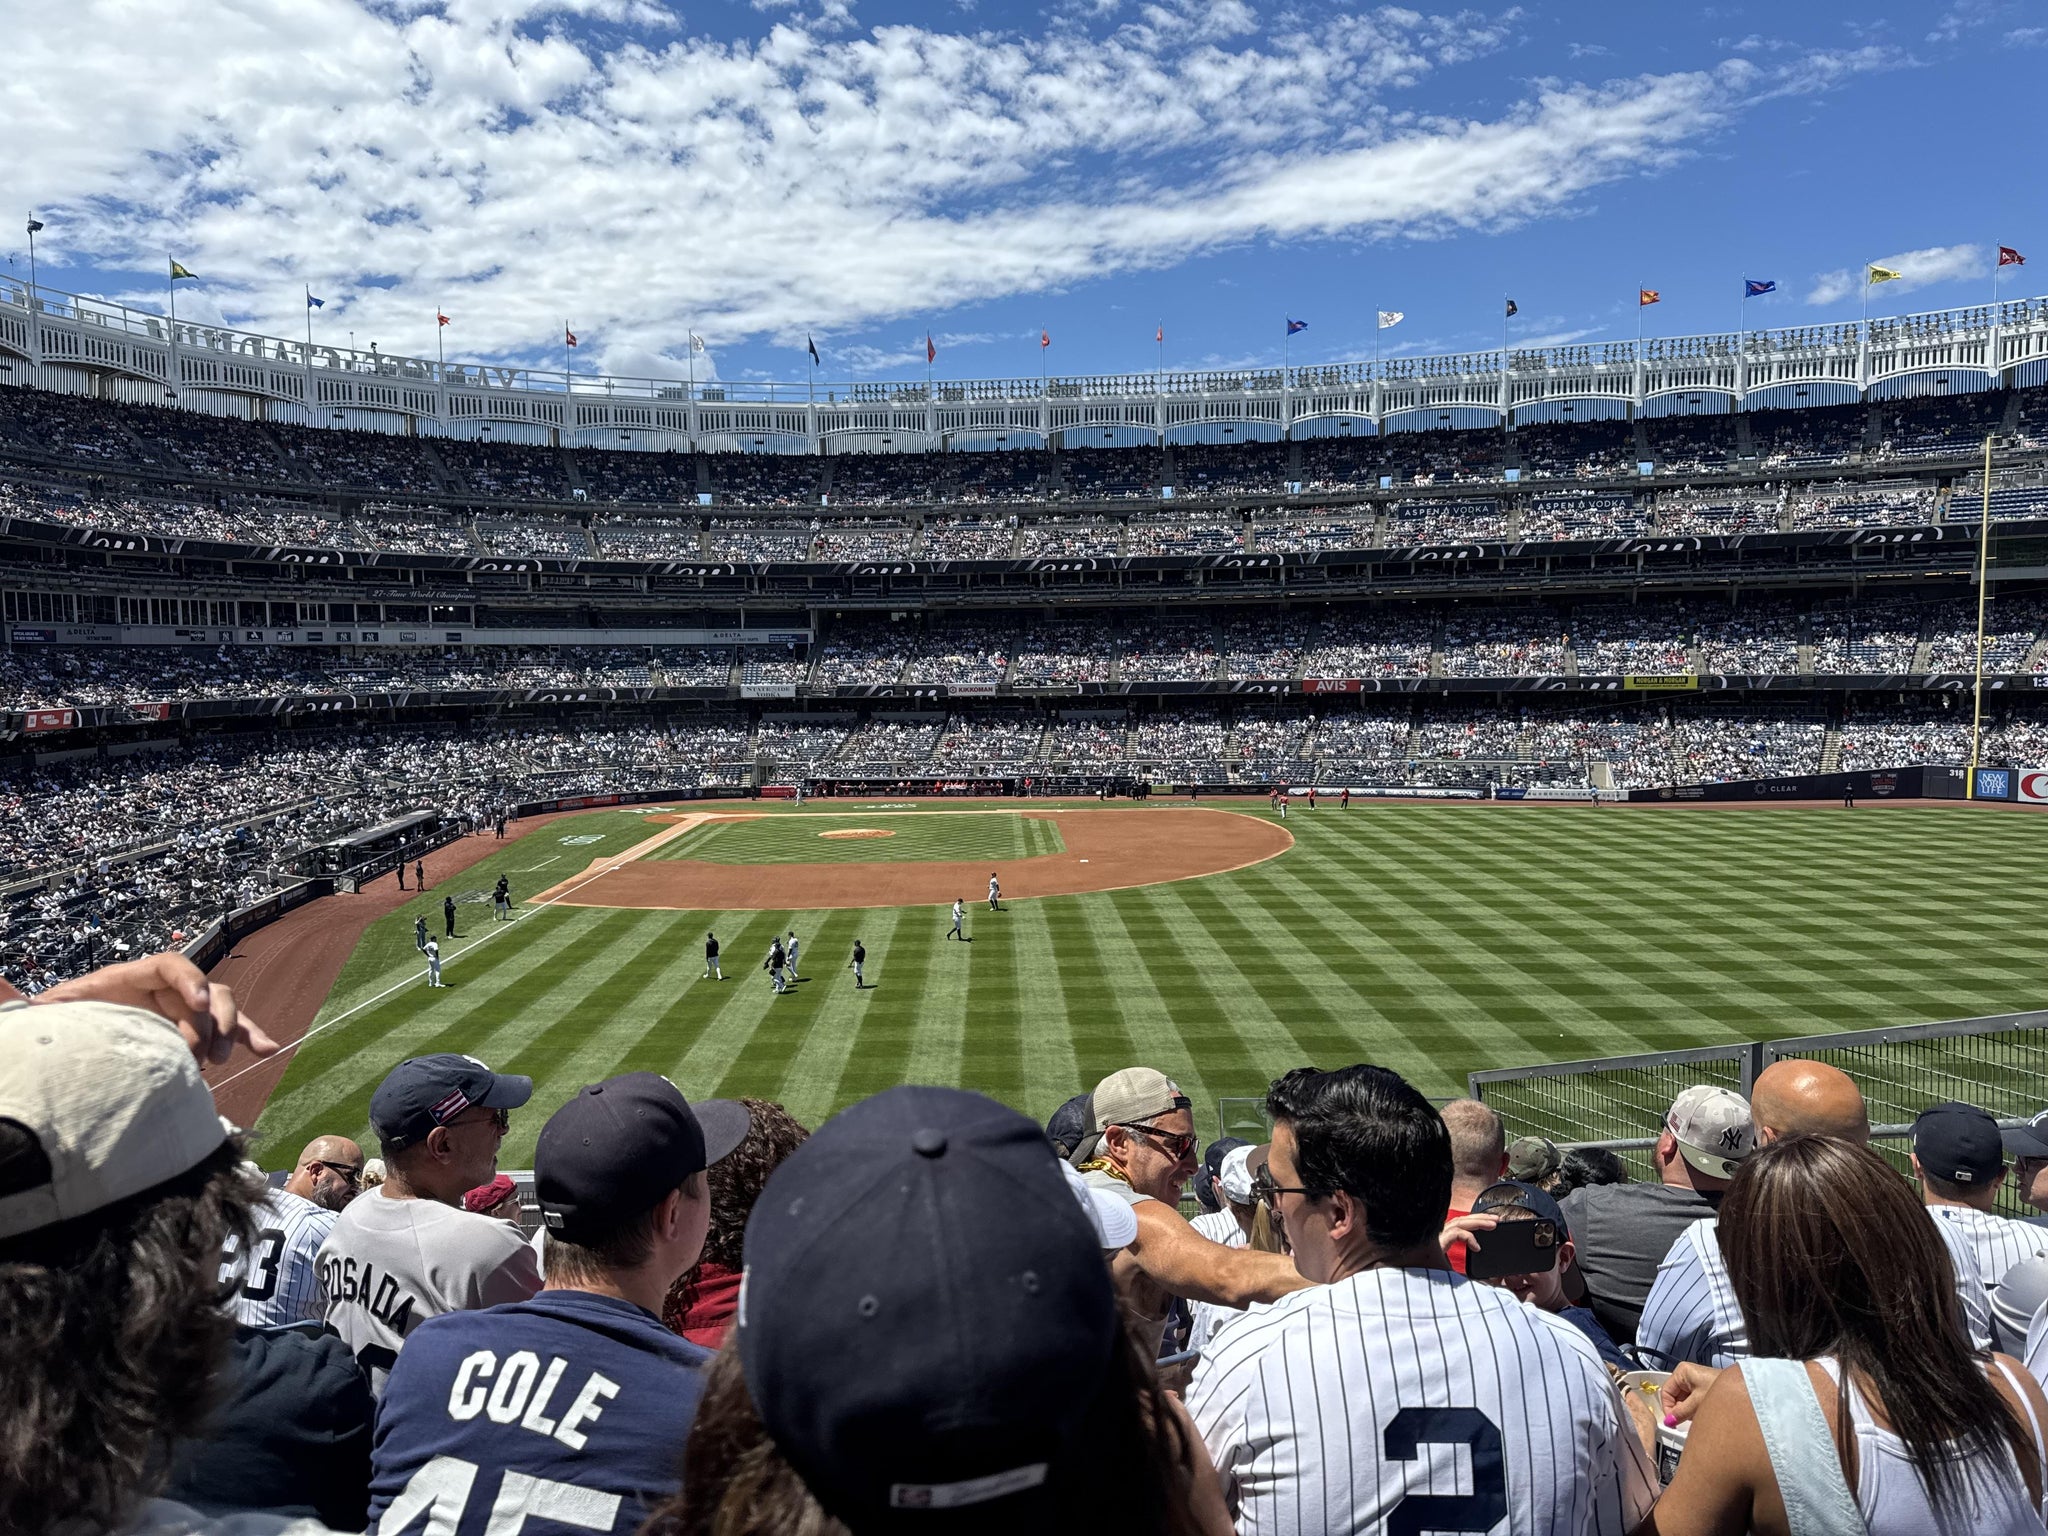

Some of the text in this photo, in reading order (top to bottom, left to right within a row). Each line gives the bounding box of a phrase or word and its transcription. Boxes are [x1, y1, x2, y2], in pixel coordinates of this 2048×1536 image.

[1404, 505, 1490, 517] ASPEN VODKA
[1537, 499, 1627, 511] ASPEN VODKA
[372, 589, 476, 601] 27-Time World Champions
[1316, 681, 1347, 691] AVIS
[1949, 769, 1964, 777] 318
[1982, 773, 2004, 781] NEW
[1980, 780, 2005, 788] YORK
[1982, 786, 2003, 794] LIFE
[1719, 1126, 1743, 1151] NY
[322, 1256, 416, 1336] POSADA
[448, 1350, 621, 1450] COLE
[1384, 1407, 1508, 1536] 2
